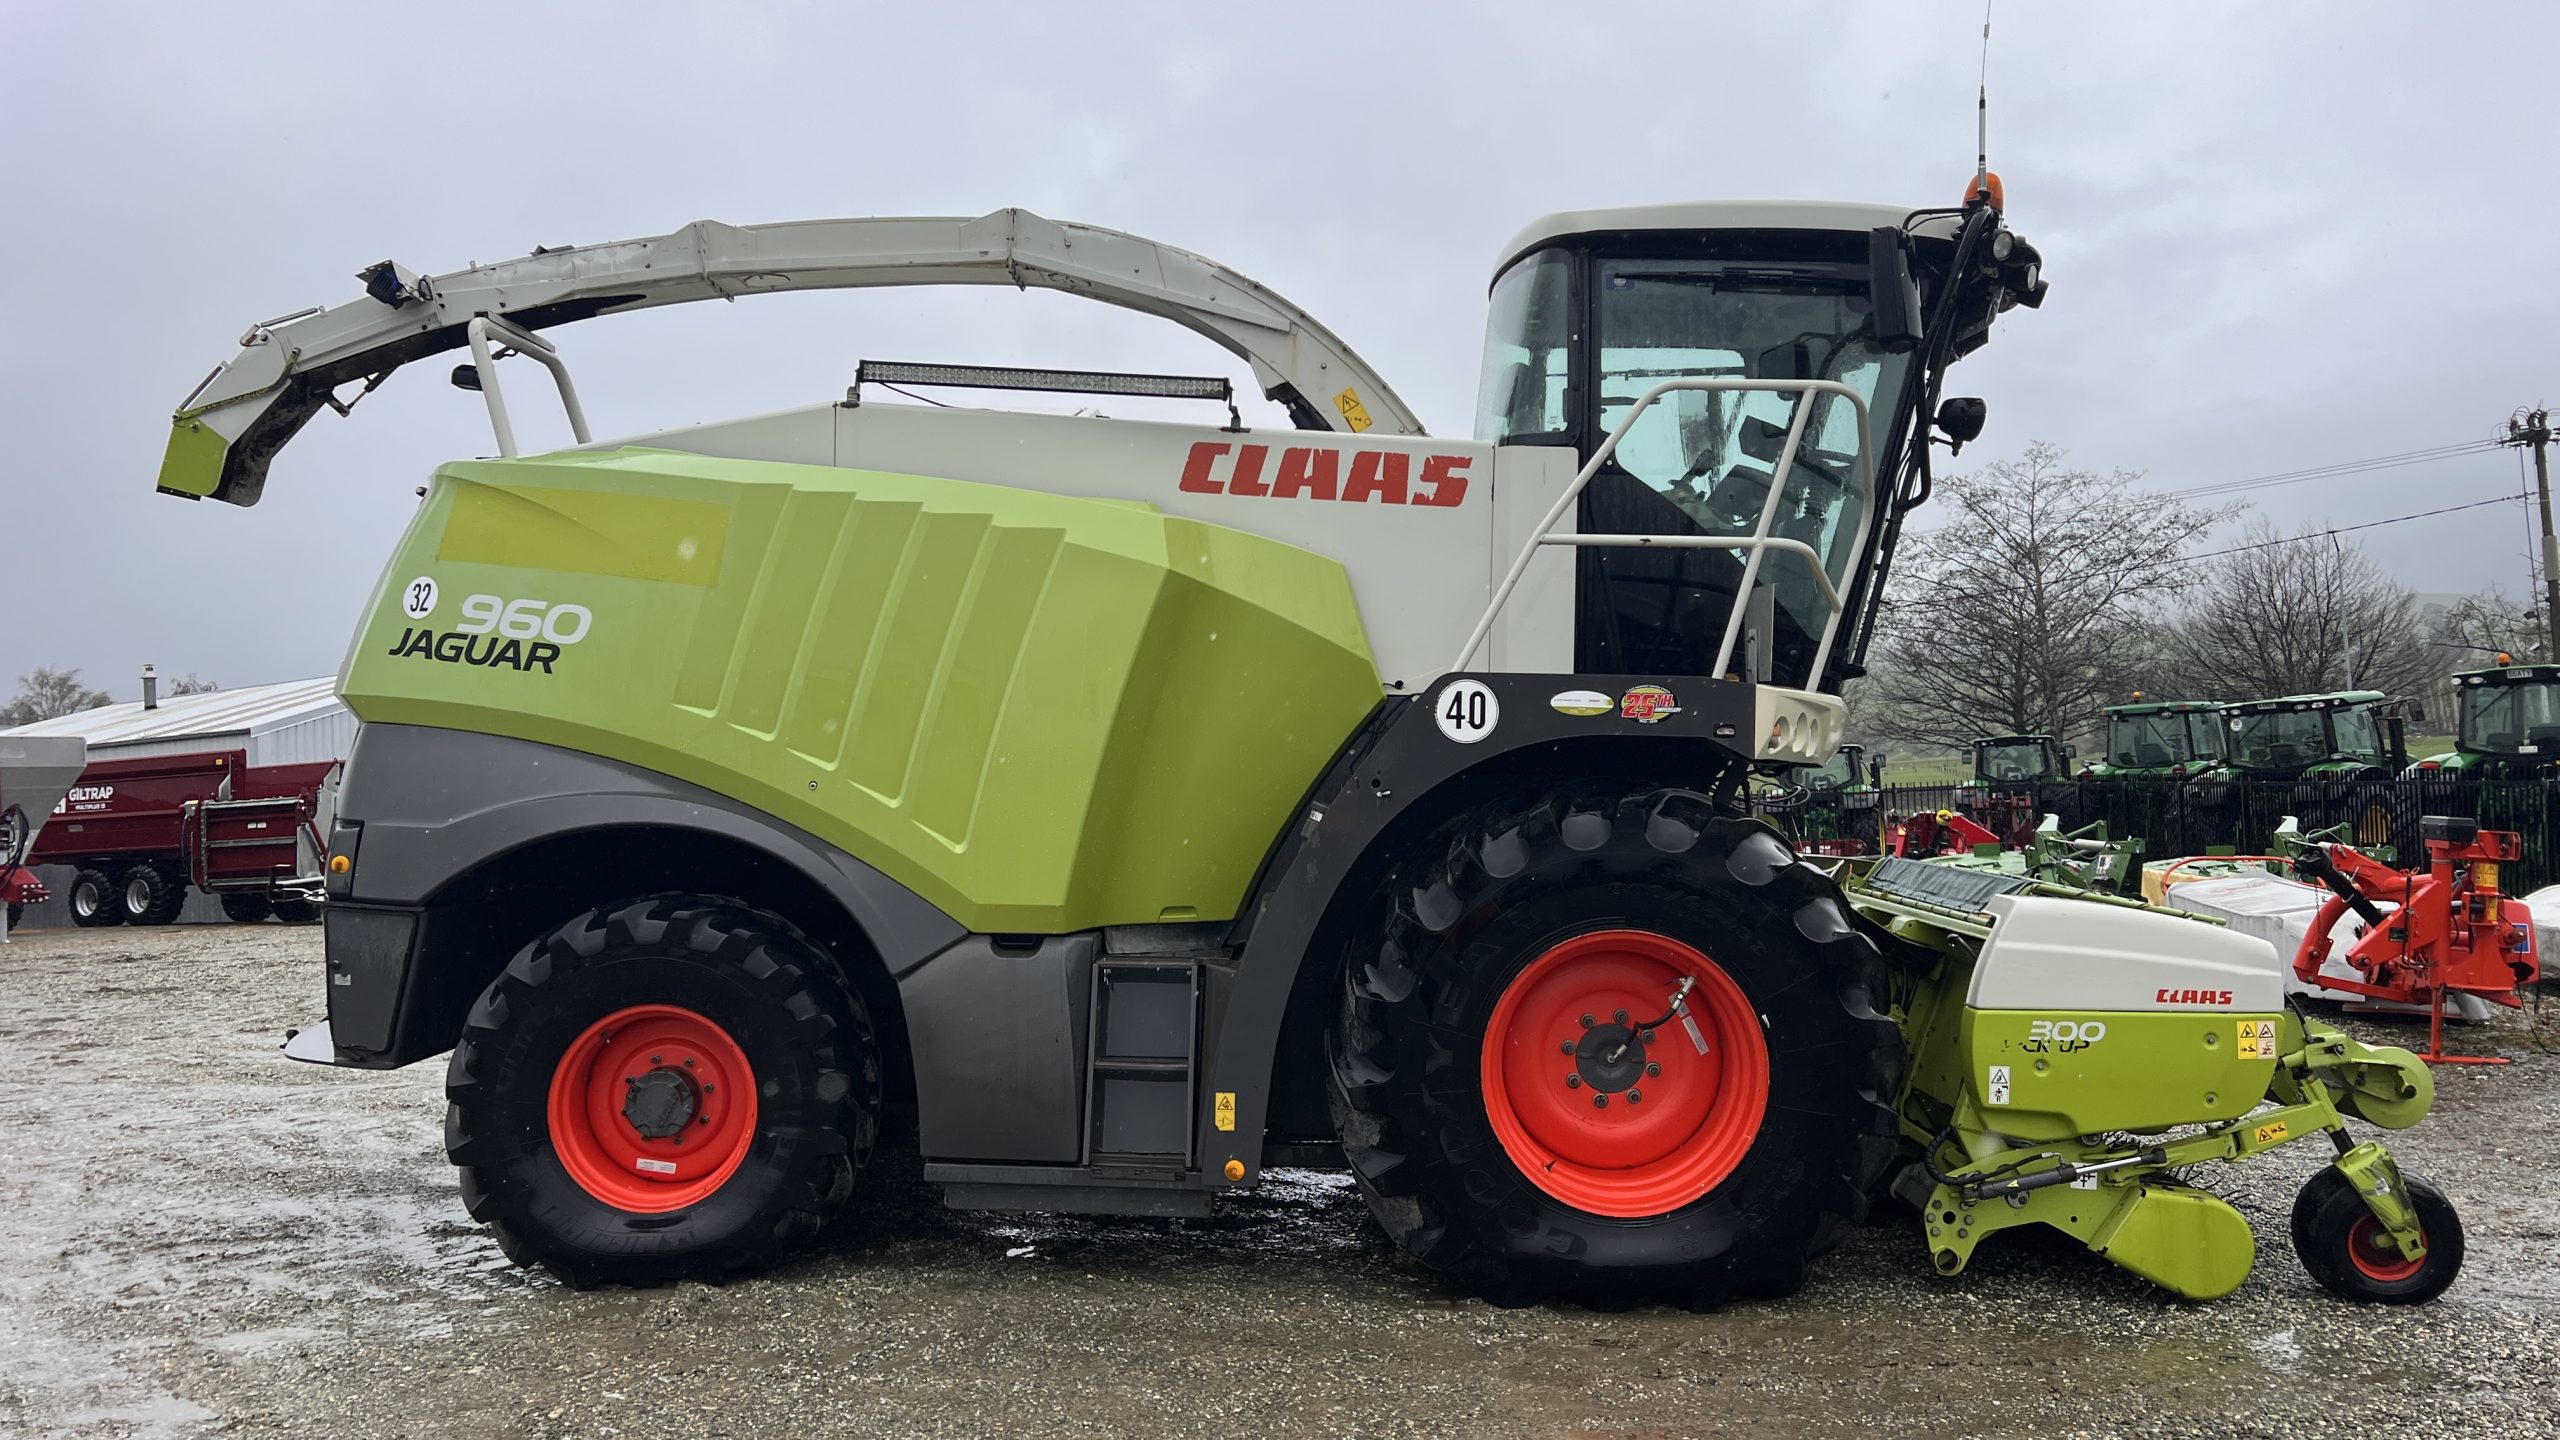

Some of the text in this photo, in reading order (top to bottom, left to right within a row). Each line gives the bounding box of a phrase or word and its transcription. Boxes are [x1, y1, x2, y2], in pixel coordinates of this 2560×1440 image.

[1179, 441, 1473, 507] CLAAS
[410, 583, 432, 612] 32
[456, 594, 592, 644] 960
[388, 628, 560, 674] JAGUAR
[1446, 691, 1486, 729] 40
[68, 786, 114, 801] GILTRAP
[2155, 989, 2233, 1005] CLAAS
[2028, 1020, 2106, 1042] 300
